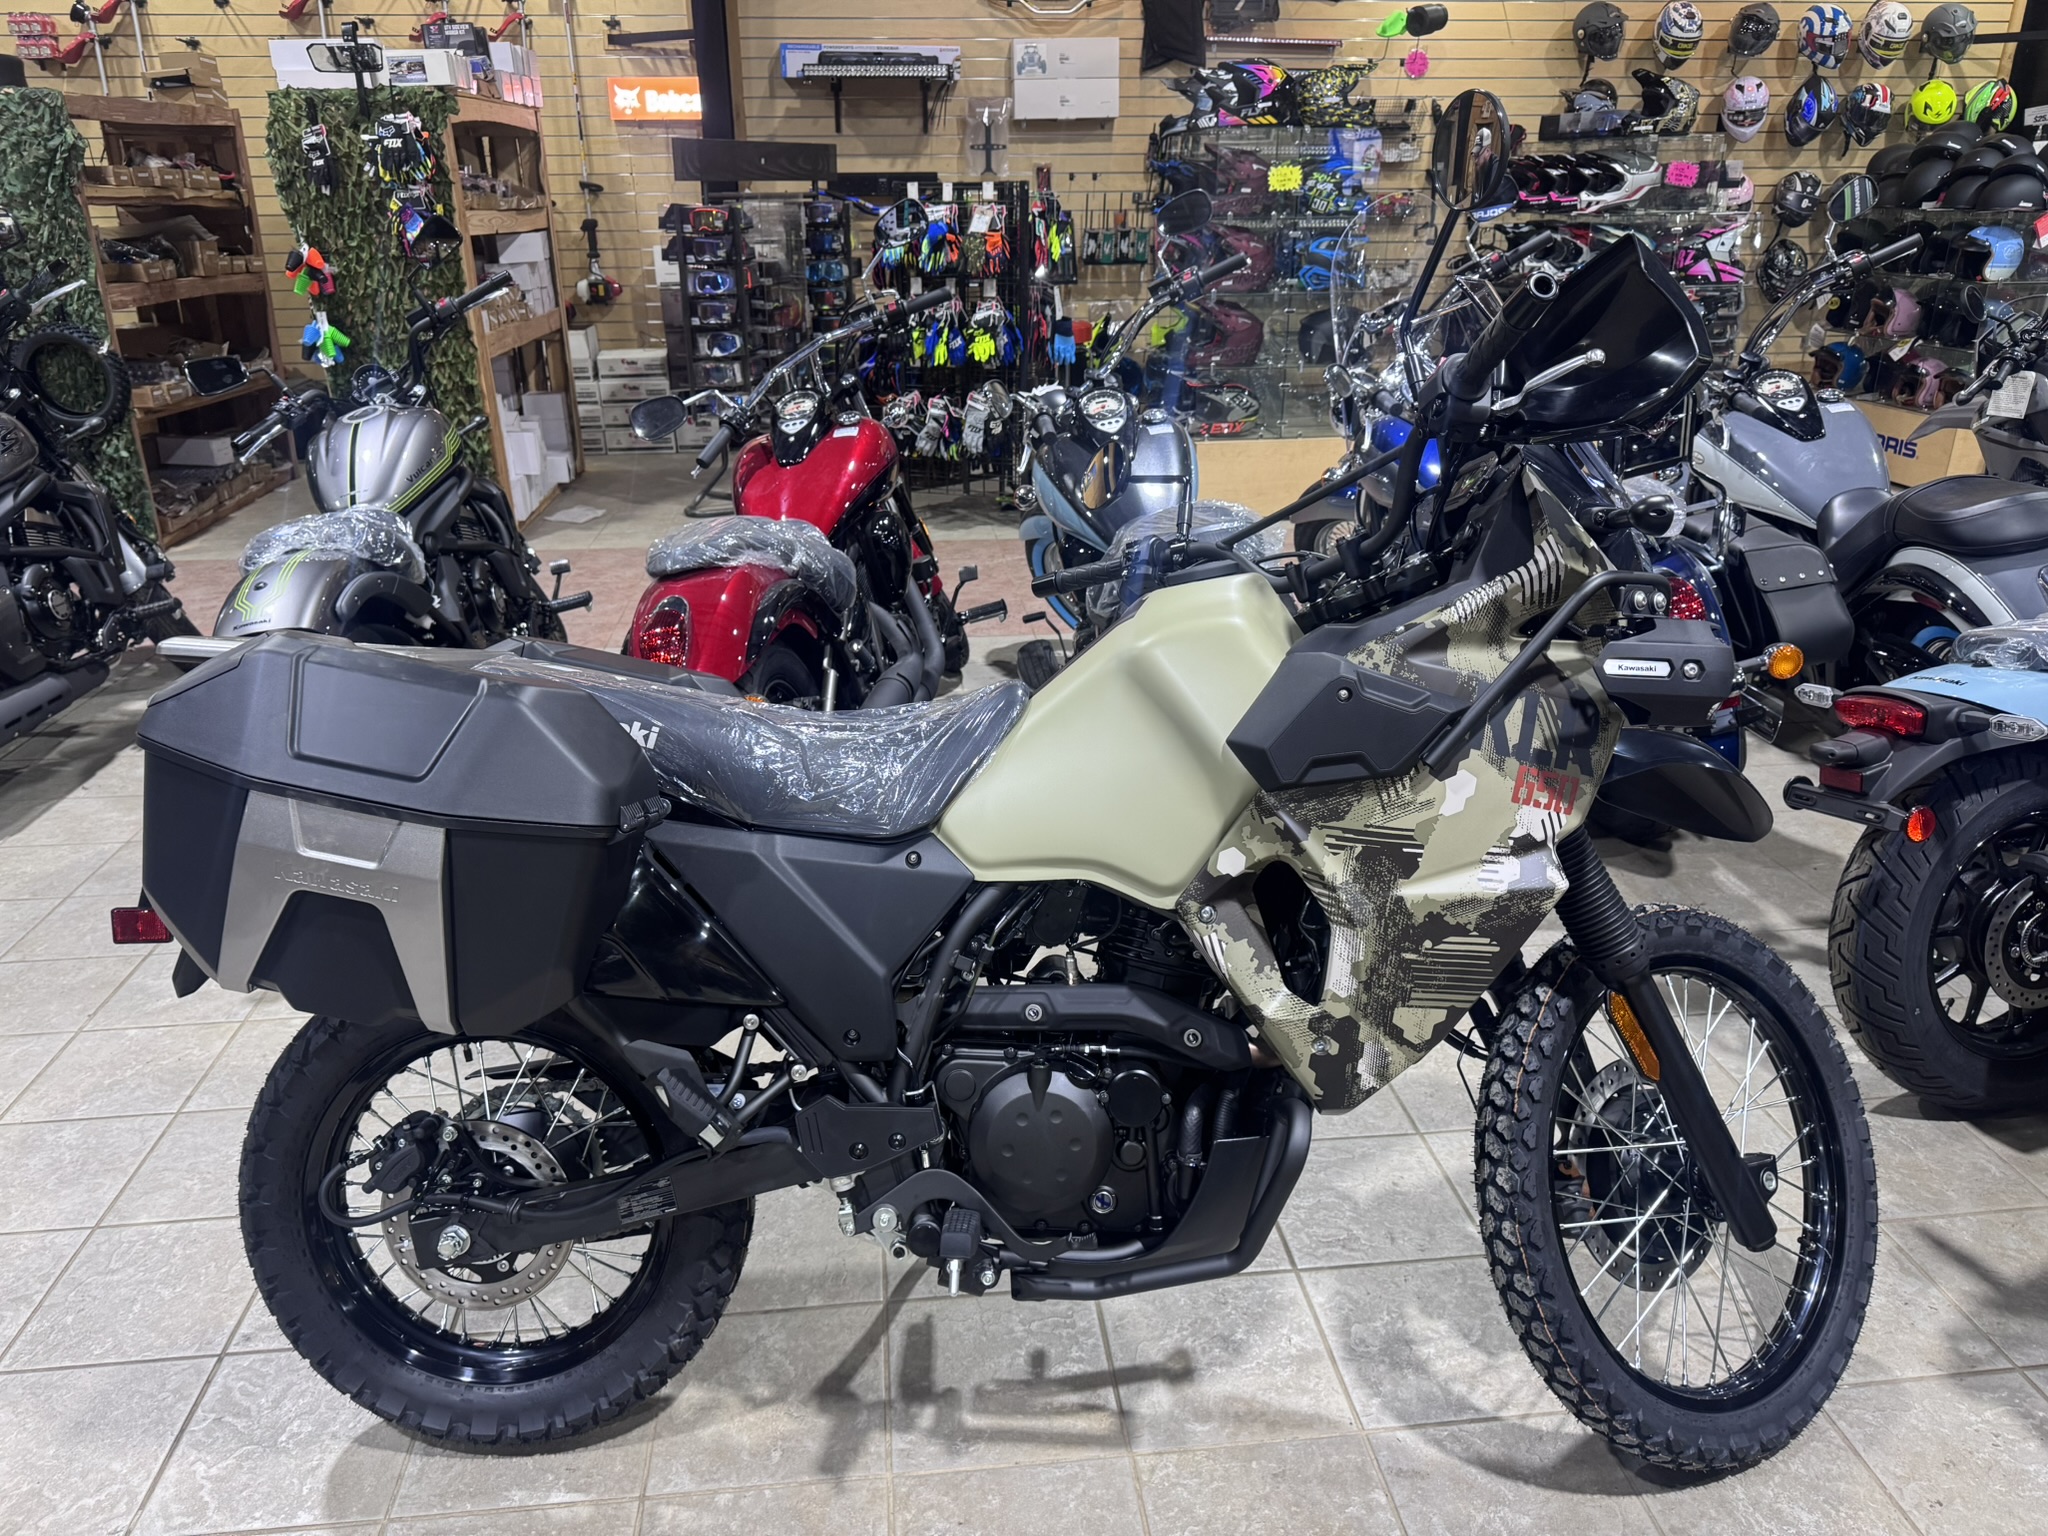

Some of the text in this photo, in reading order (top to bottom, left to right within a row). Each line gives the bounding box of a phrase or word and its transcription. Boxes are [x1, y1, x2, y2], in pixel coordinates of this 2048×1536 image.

[383, 138, 403, 148] FOX
[406, 458, 436, 483] Vulcan
[233, 618, 271, 631] Kawasaki
[1618, 664, 1657, 672] Kawasaki
[1511, 765, 1580, 815] 650
